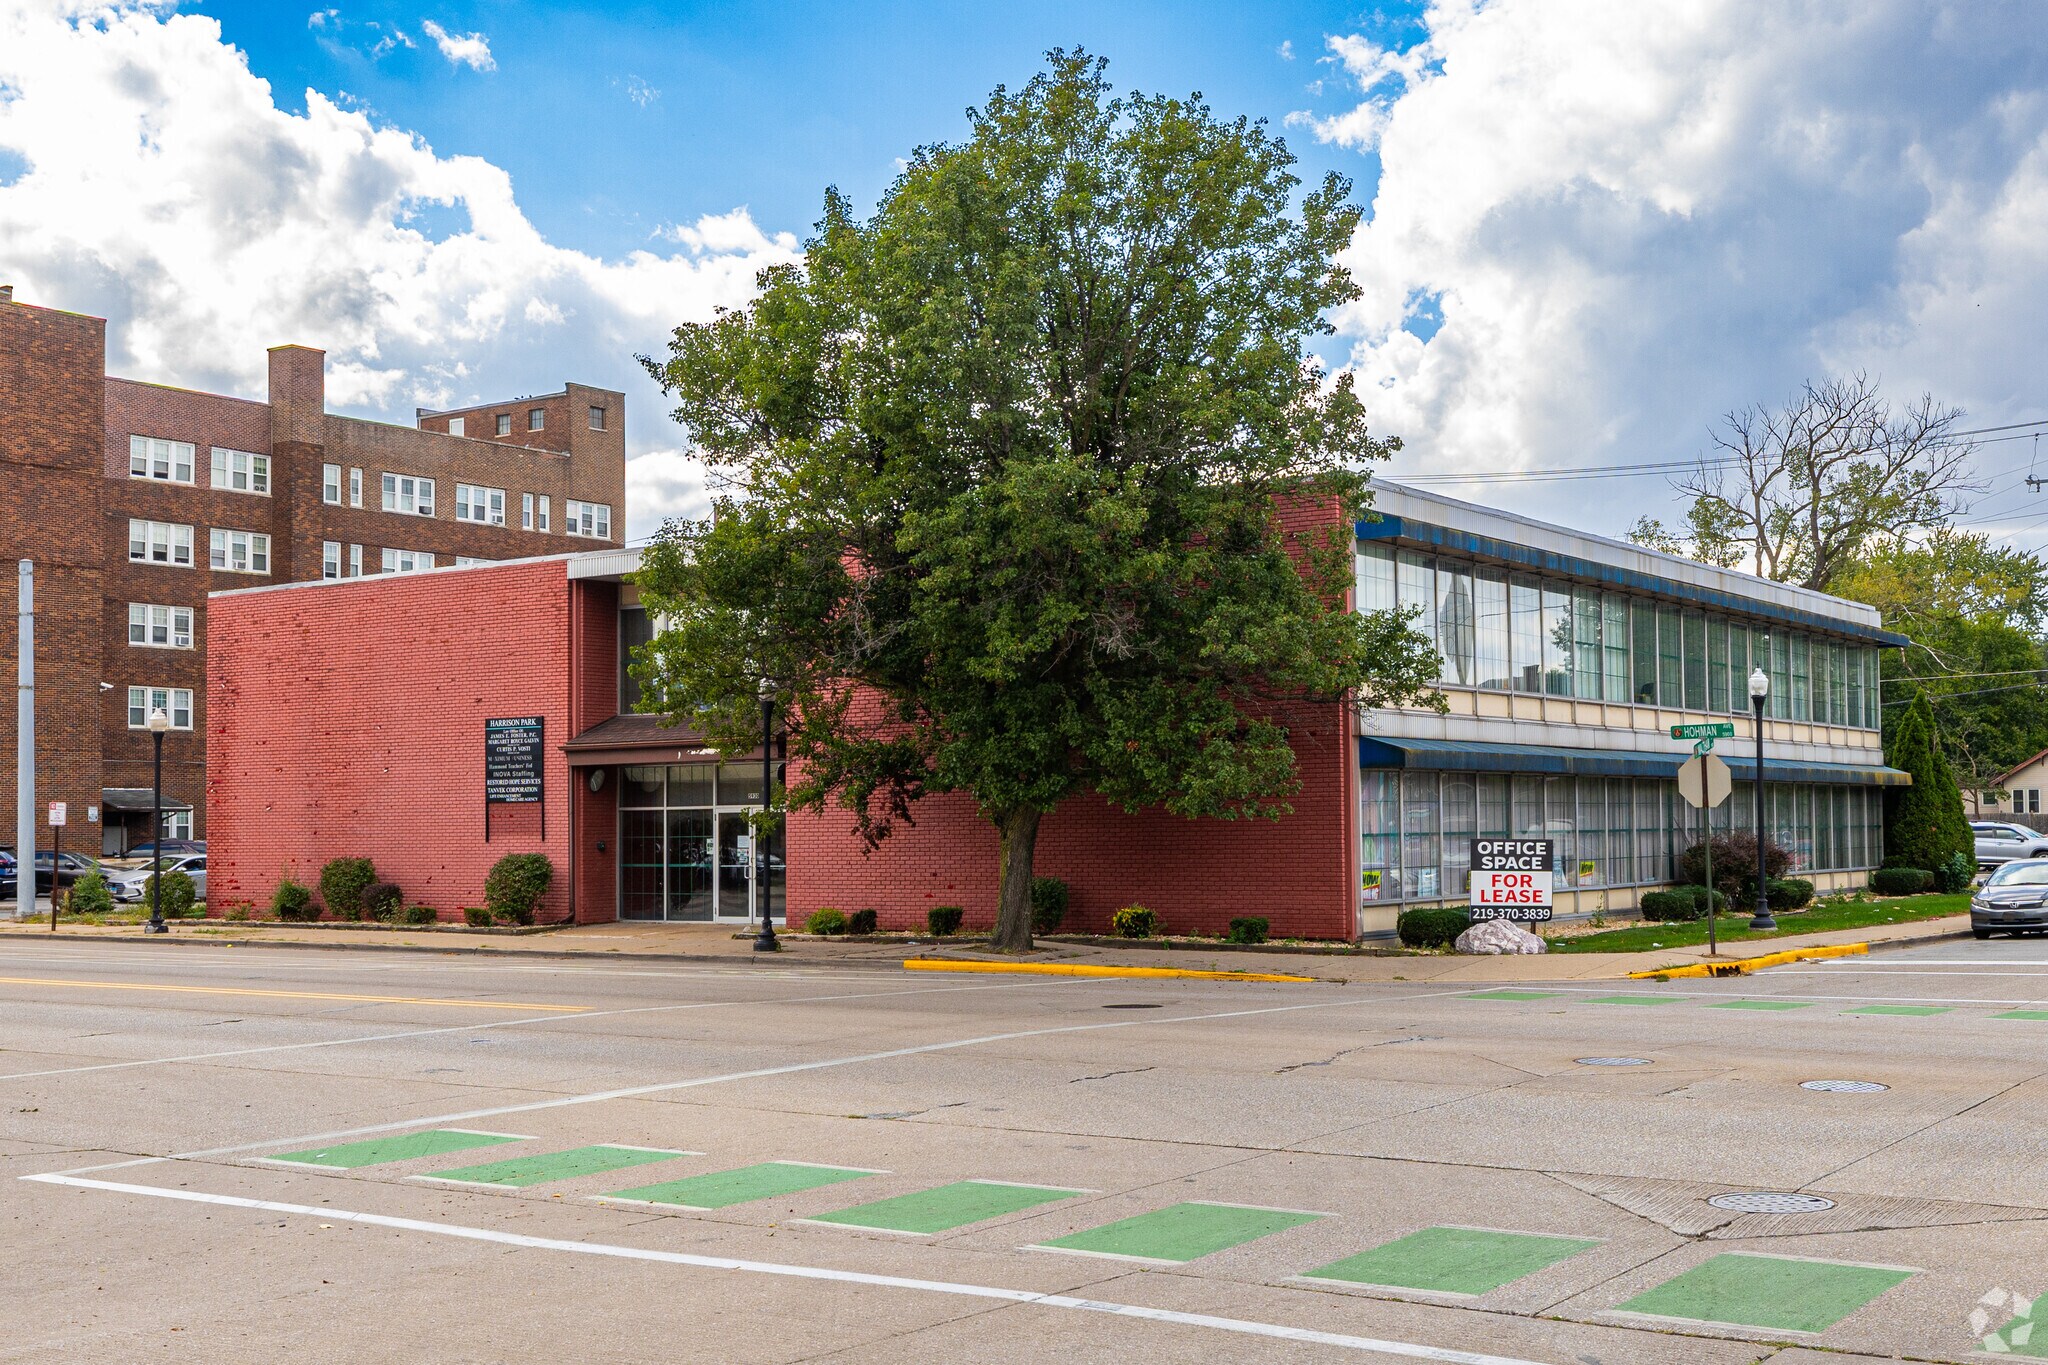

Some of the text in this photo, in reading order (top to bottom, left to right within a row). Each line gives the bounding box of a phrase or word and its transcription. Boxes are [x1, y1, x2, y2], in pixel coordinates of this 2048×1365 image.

[490, 718, 536, 727] HARRISON PARK
[1684, 725, 1717, 737] HOHMAN
[1477, 842, 1546, 855] OFFICE
[1481, 856, 1542, 870] SPACE
[1492, 874, 1532, 888] FOR
[1480, 890, 1543, 903] LEASE
[1472, 908, 1550, 919] 219-370-3839
